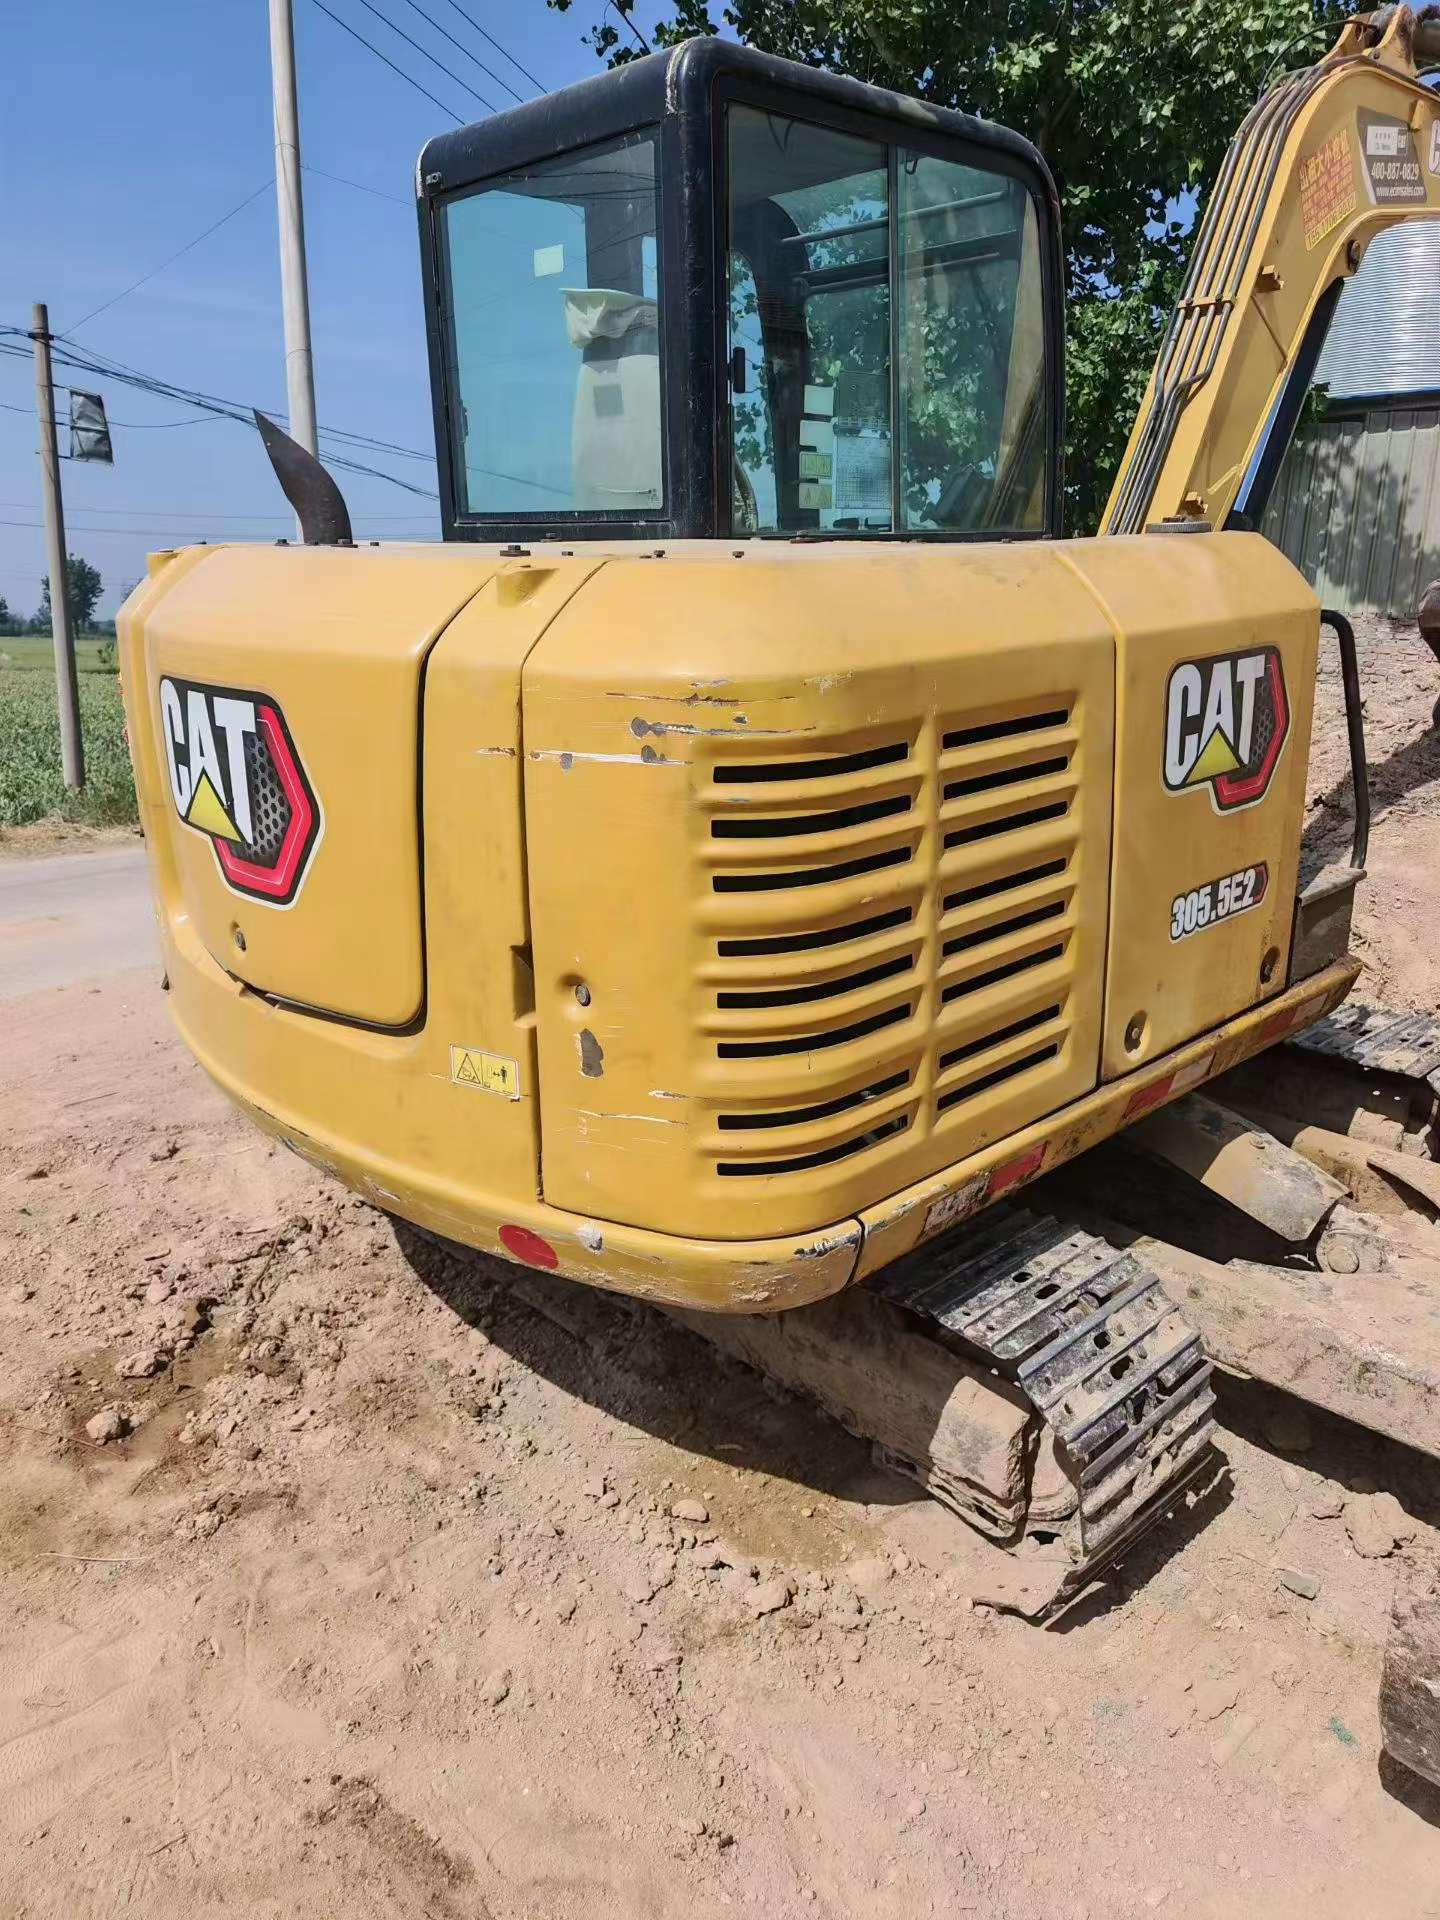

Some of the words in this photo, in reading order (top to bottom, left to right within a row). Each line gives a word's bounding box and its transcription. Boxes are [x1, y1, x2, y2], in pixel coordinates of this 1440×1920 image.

[160, 679, 257, 845] CAT
[1165, 654, 1266, 786] CAT
[1171, 867, 1257, 940] 305.5E2
